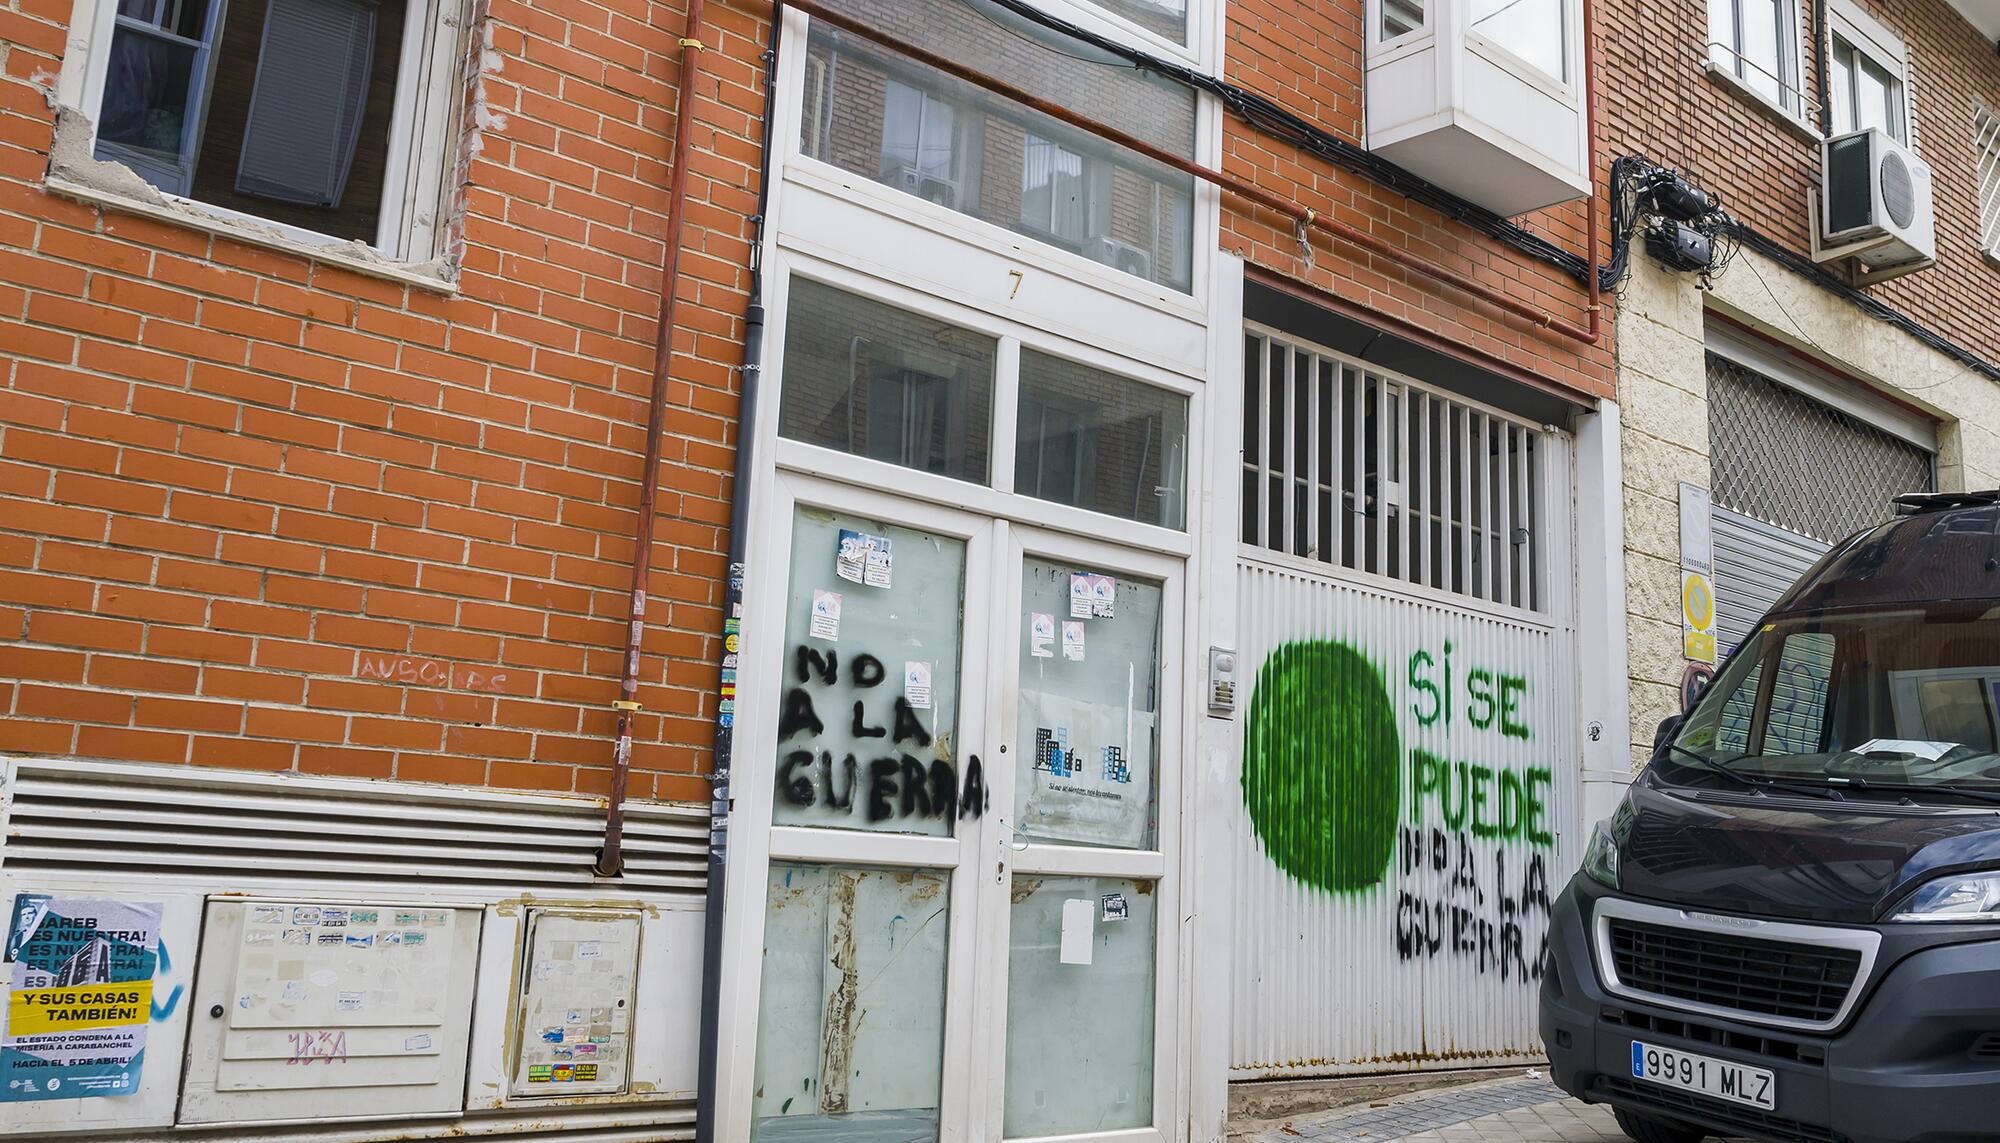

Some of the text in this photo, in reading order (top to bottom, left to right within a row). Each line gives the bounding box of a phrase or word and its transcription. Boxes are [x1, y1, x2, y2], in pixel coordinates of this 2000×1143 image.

[1008, 268, 1023, 300] 7
[796, 645, 886, 688] NO
[1467, 666, 1530, 740] SE
[779, 687, 931, 747] A LA
[1408, 748, 1554, 848] PUEDE
[31, 930, 147, 942] ES NUESTRA!
[28, 945, 52, 956] ES
[26, 959, 51, 971] ES
[24, 976, 47, 988] ES
[24, 992, 140, 1006] Y SUS CASAS
[46, 1005, 138, 1021] TAMBIÉN!
[68, 1034, 113, 1042] CONDENA
[68, 1042, 134, 1050] CARABANCHEL
[12, 1056, 132, 1069] HACIA EL 5 DE ABRIL!
[1647, 1050, 1706, 1089] 9991
[1721, 1065, 1770, 1105] MLZ
